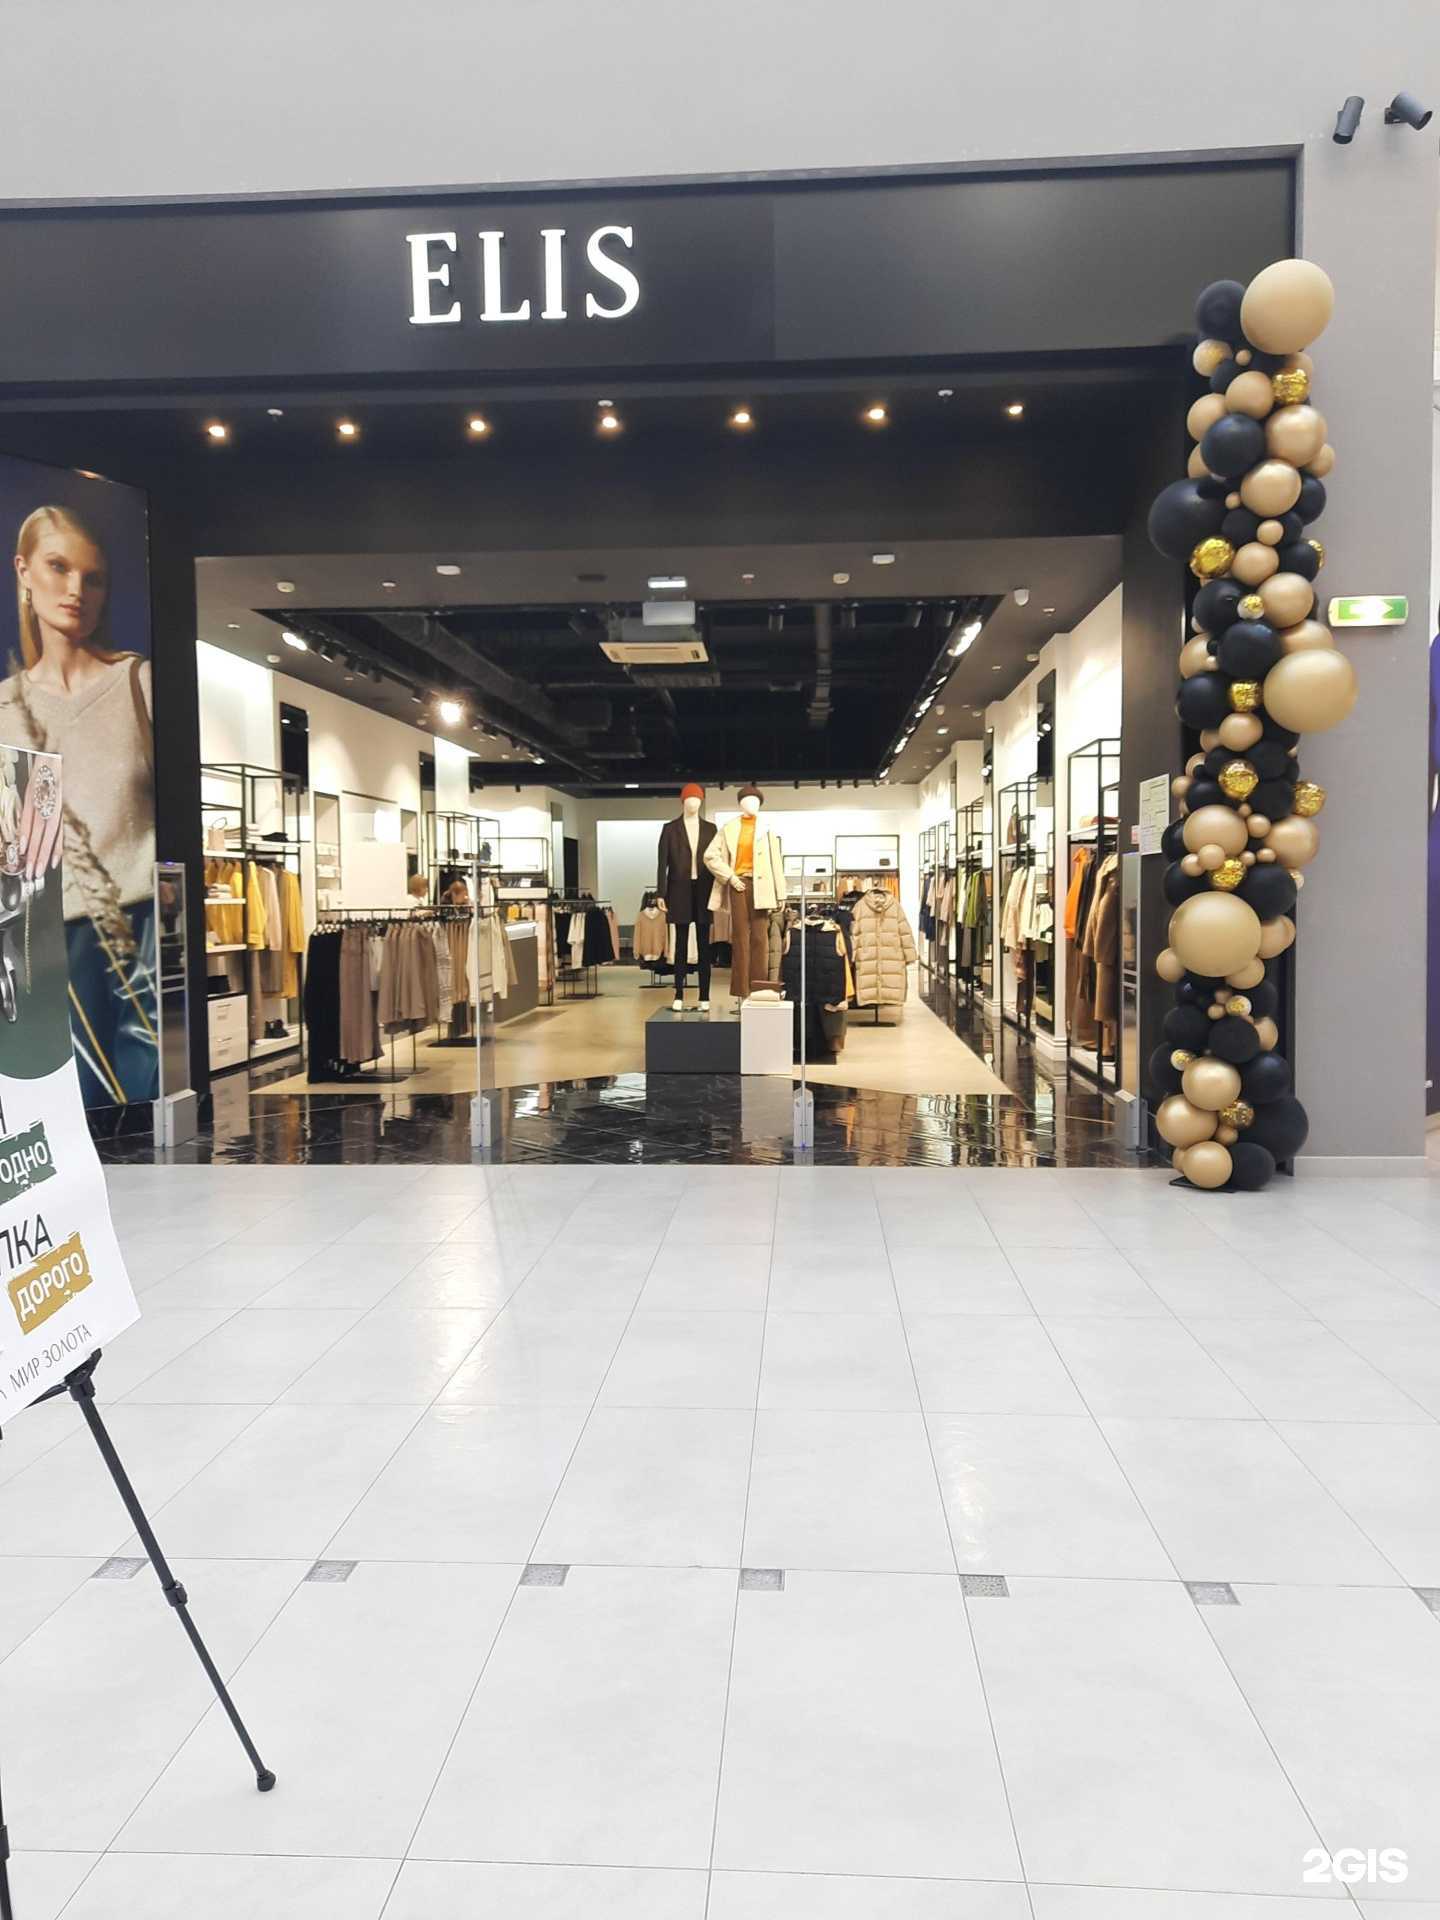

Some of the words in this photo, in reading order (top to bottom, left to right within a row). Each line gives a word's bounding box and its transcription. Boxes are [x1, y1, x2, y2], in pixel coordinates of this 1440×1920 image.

[406, 226, 640, 324] ELIS
[17, 1252, 84, 1322] ДОРОГО
[10, 1357, 40, 1392] МИР
[42, 1324, 92, 1368] ЗОЛОТА
